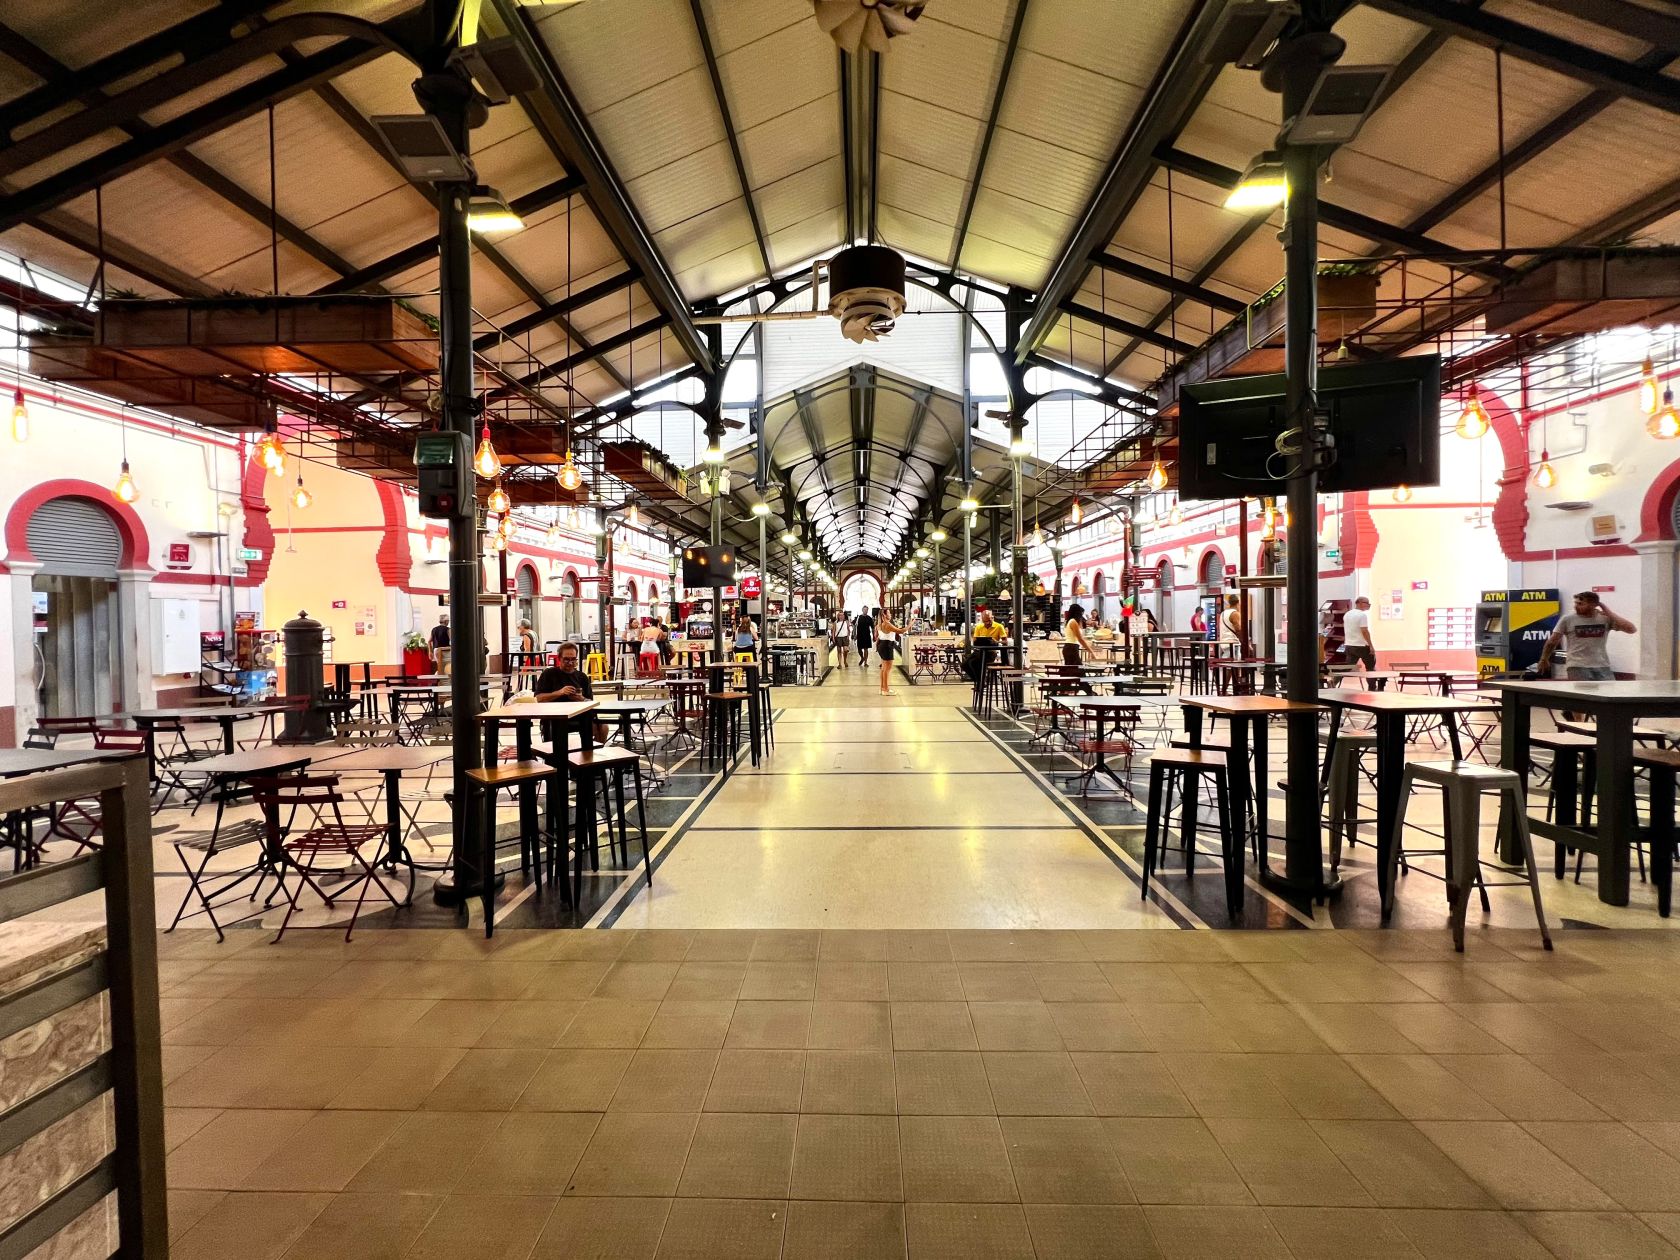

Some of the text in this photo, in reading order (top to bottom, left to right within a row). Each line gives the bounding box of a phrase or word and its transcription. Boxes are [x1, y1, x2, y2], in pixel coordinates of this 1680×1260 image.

[1484, 592, 1506, 601] ATM
[1522, 591, 1546, 600] ATM
[1522, 630, 1551, 641] ATM
[914, 655, 963, 664] VEGETA
[1482, 664, 1500, 673] ATM
